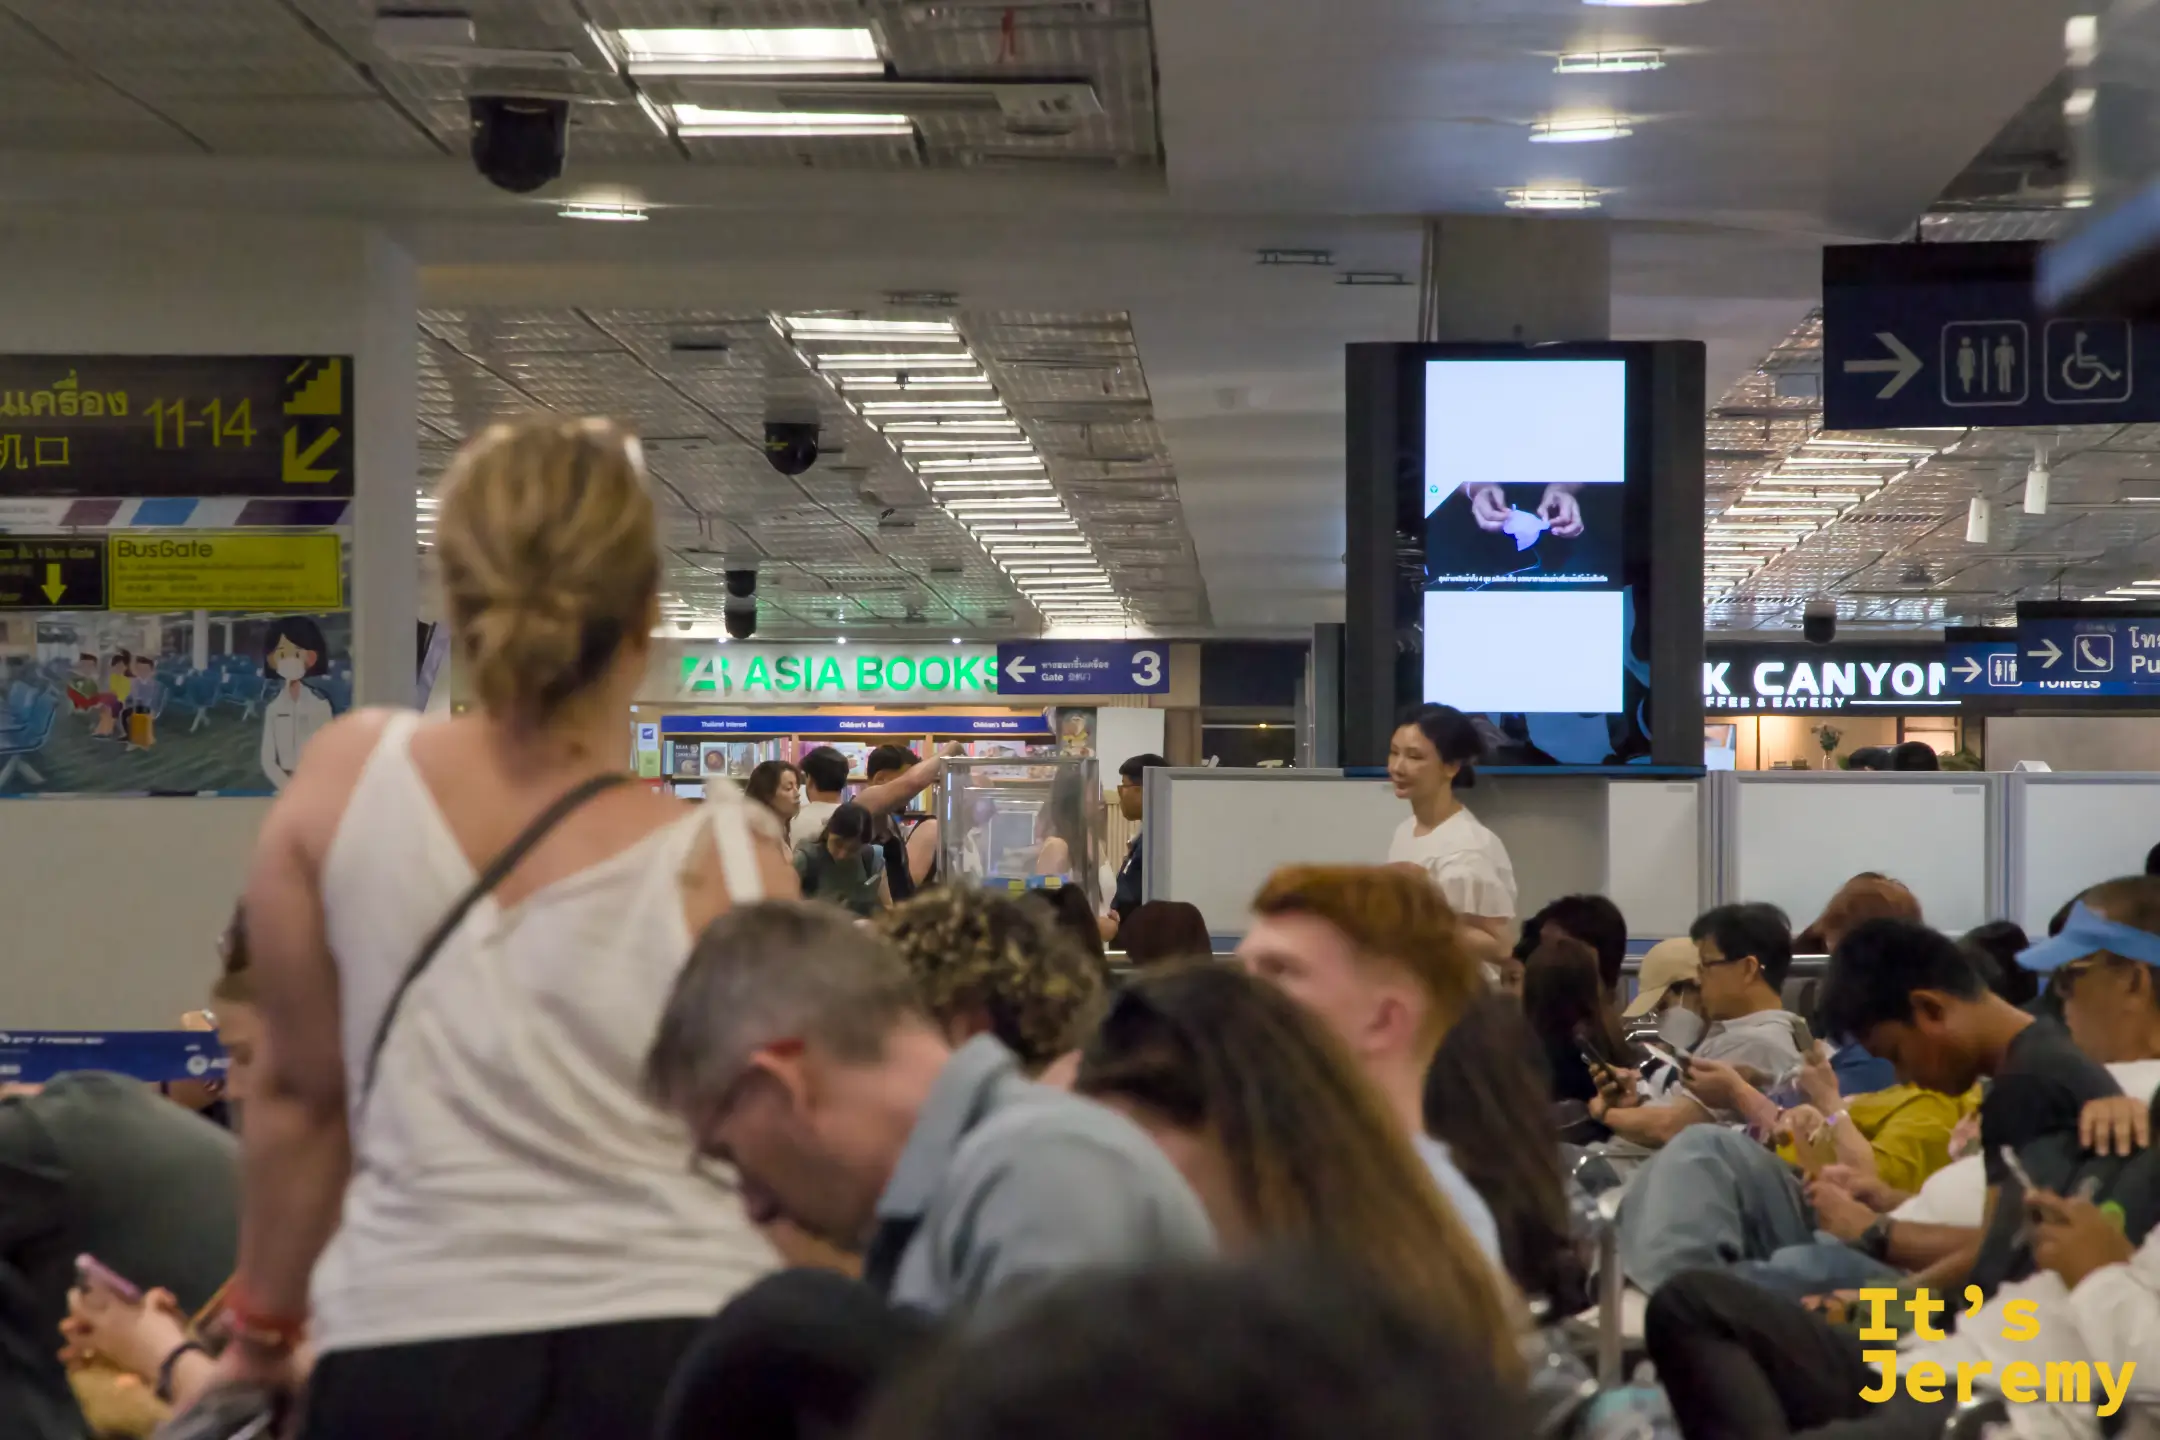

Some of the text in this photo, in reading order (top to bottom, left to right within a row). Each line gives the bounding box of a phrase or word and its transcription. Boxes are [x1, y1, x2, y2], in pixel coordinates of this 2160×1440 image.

[143, 397, 257, 448] 11-14
[2128, 626, 2160, 649] โท
[743, 655, 847, 692] ASIA
[856, 655, 998, 692] BOOKS
[1041, 672, 1064, 682] Gate
[1131, 650, 1161, 687] 3
[1756, 696, 1766, 708] &
[1772, 696, 1846, 708] EATERY
